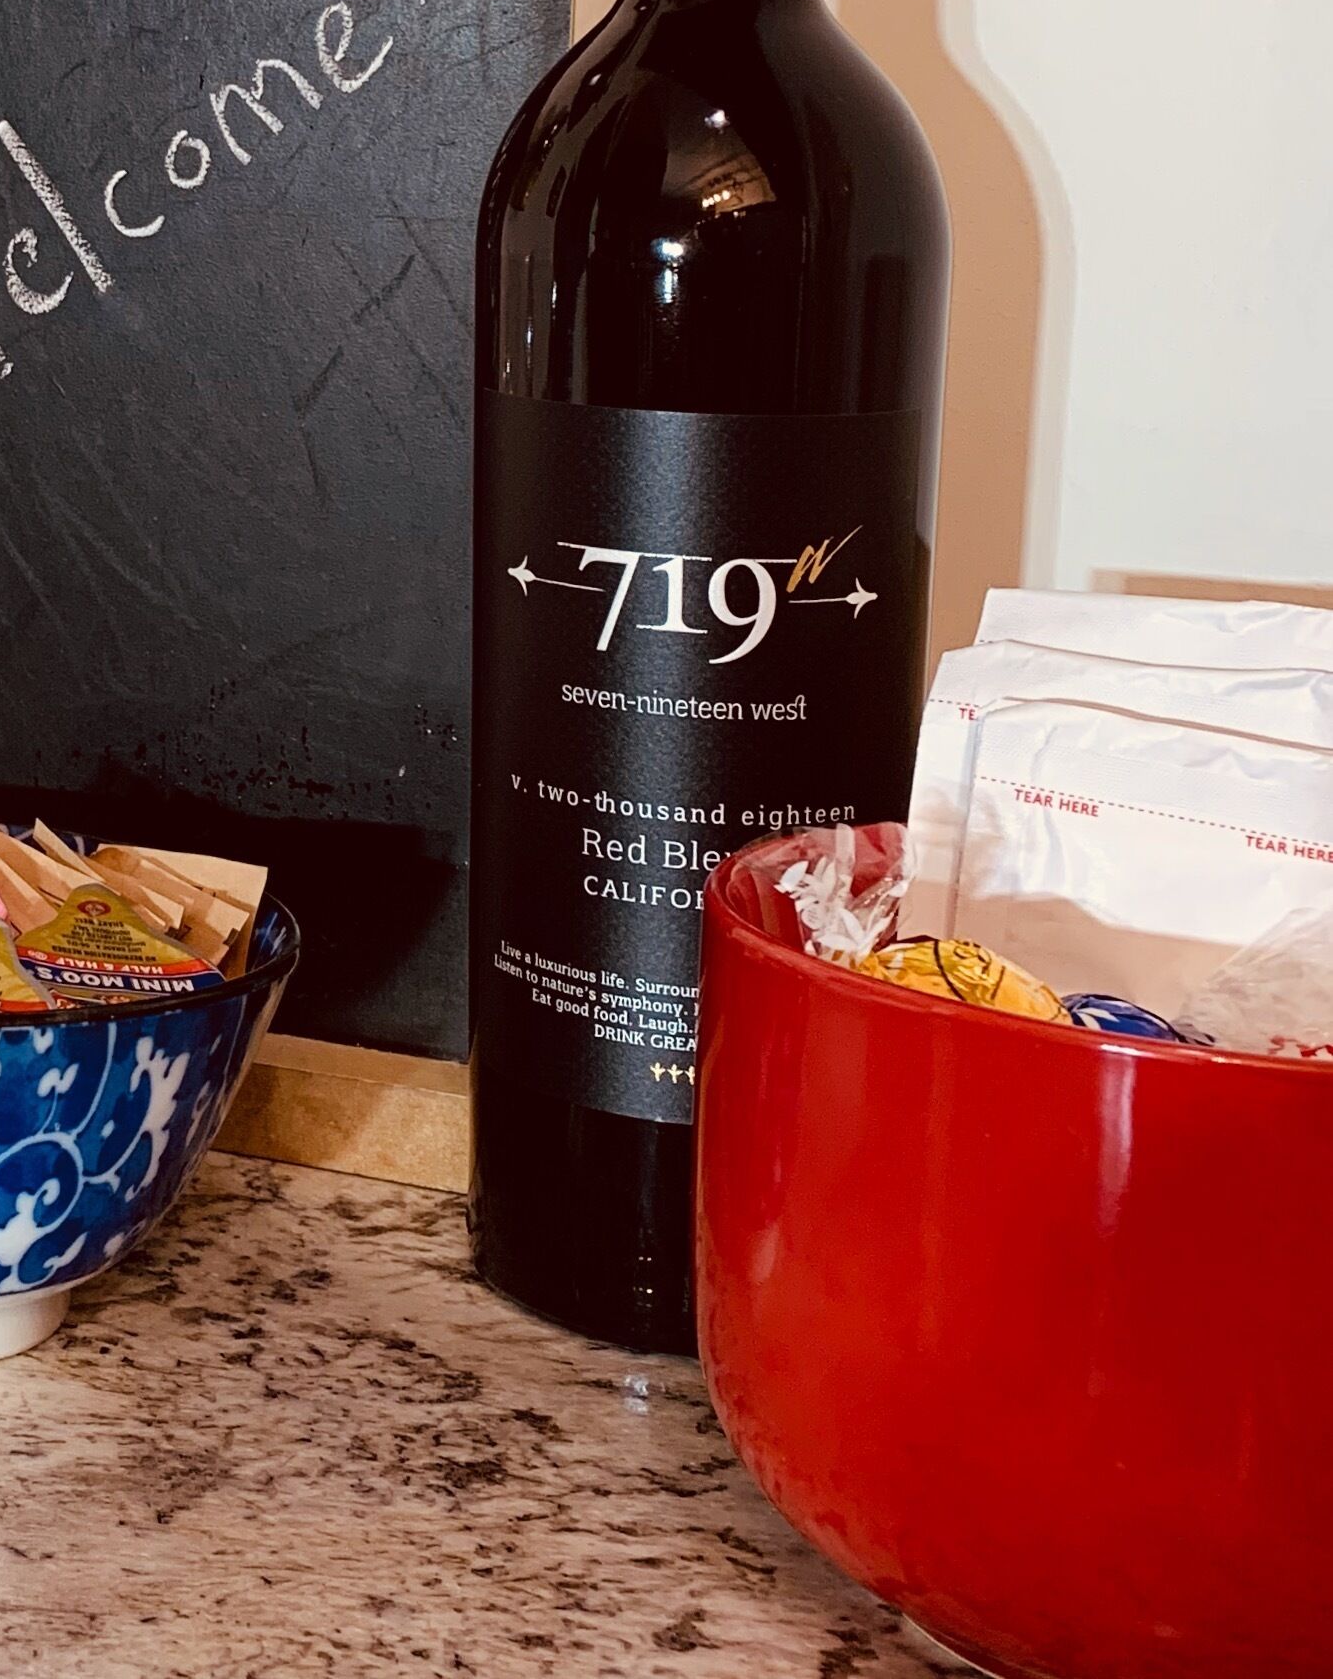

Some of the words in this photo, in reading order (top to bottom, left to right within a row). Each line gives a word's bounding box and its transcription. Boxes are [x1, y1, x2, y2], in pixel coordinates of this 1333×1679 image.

[561, 682, 744, 721] seven-nineteen
[750, 694, 808, 721] west
[511, 772, 528, 794] v.
[537, 779, 726, 825] two-thousand
[741, 802, 856, 830] eighteen
[1014, 788, 1054, 808] TEAR
[1058, 798, 1100, 818] HERE
[581, 827, 648, 866] Red
[1245, 835, 1289, 856] TEAR
[1293, 845, 1333, 864] HERE
[54, 957, 99, 970] HALF
[120, 964, 164, 975] HALF
[500, 939, 522, 960] Live
[525, 953, 532, 965] a
[534, 952, 597, 983] luxurious
[601, 970, 630, 990] life.
[130, 978, 195, 992] MINI
[494, 953, 523, 979] Listen
[525, 969, 539, 984] to
[541, 976, 597, 1001] nature's
[601, 991, 689, 1018] symphony.
[532, 988, 552, 1006] Eat
[555, 996, 589, 1017] good
[593, 1005, 633, 1026] food.
[638, 1013, 694, 1036] Laugh.
[594, 1023, 646, 1047] DRINK
